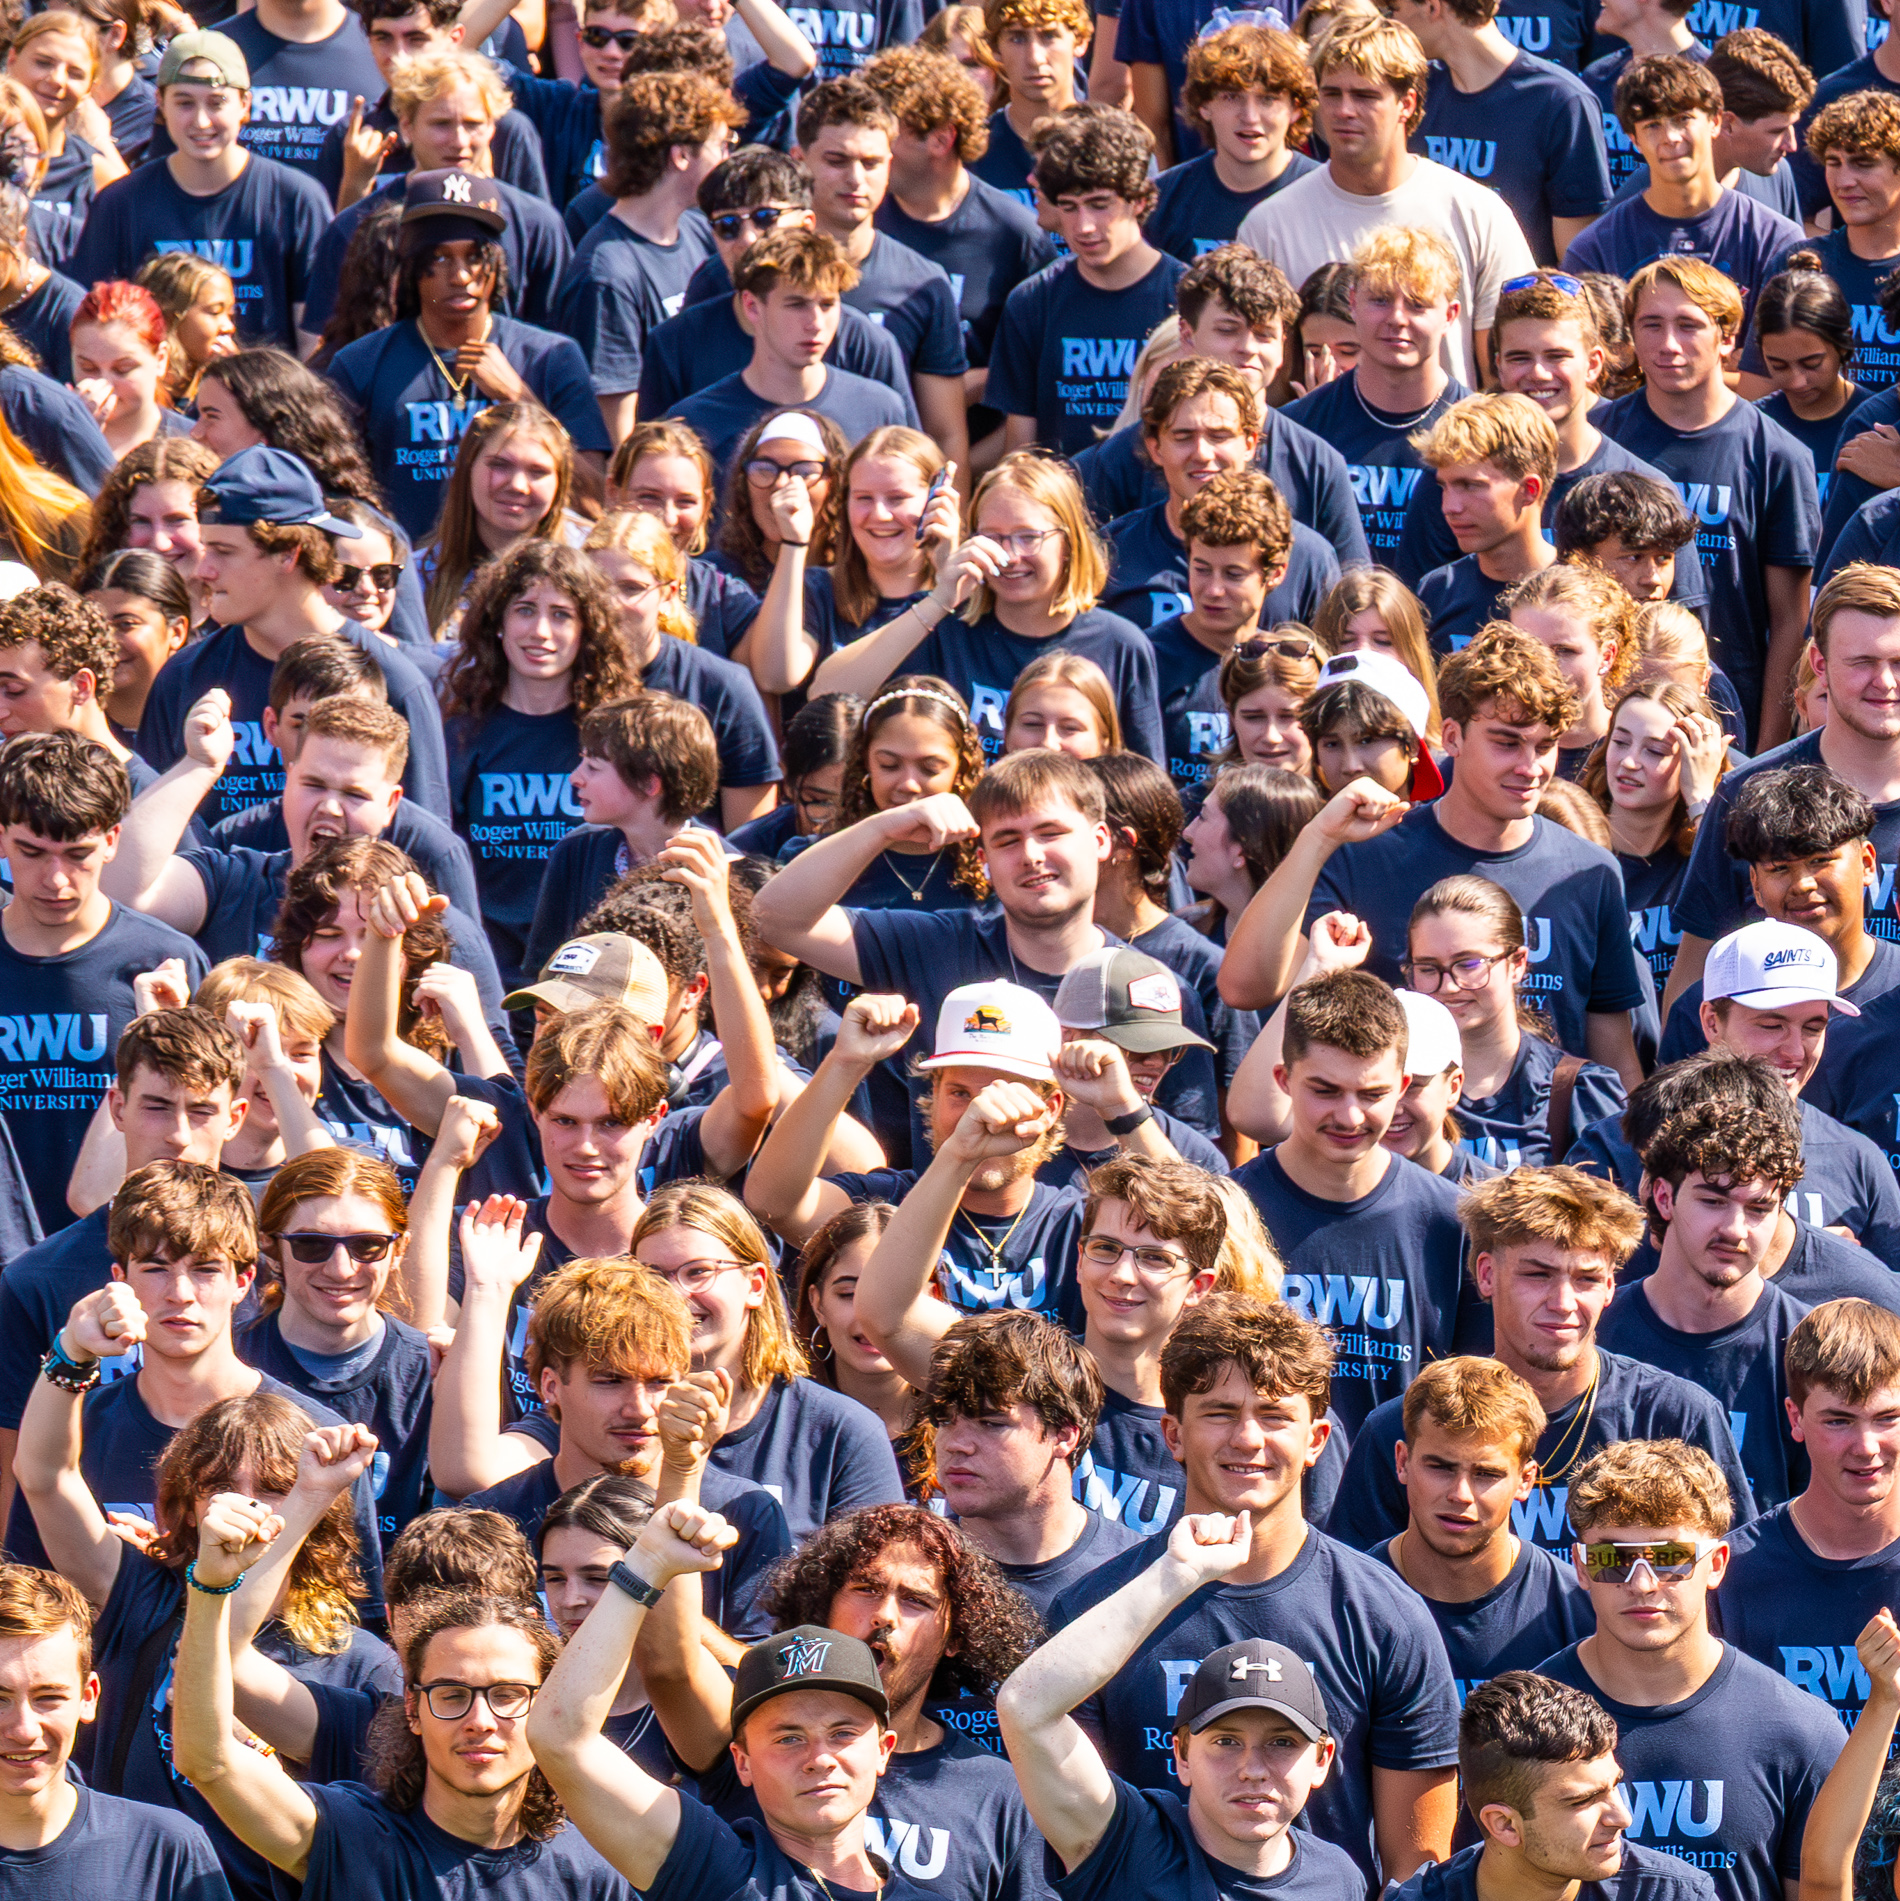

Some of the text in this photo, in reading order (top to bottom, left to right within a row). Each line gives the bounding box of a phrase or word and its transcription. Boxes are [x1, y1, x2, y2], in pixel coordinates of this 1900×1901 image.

[1495, 16, 1550, 51] WU
[250, 87, 349, 124] RWU
[405, 401, 477, 442] RW
[1347, 465, 1422, 505] RW
[233, 722, 285, 765] RW
[216, 774, 256, 792] oger
[470, 821, 575, 843] Roger Willia
[481, 844, 552, 860] UNIVER
[1631, 905, 1683, 951] WU
[1763, 948, 1812, 967] SAINTS
[0, 1072, 28, 1092] ger
[0, 1094, 102, 1111] NIVERSITY
[1281, 1274, 1405, 1328] RWU
[938, 1708, 999, 1733] Roge
[1620, 1781, 1725, 1839] WU
[865, 1816, 950, 1880] WU
